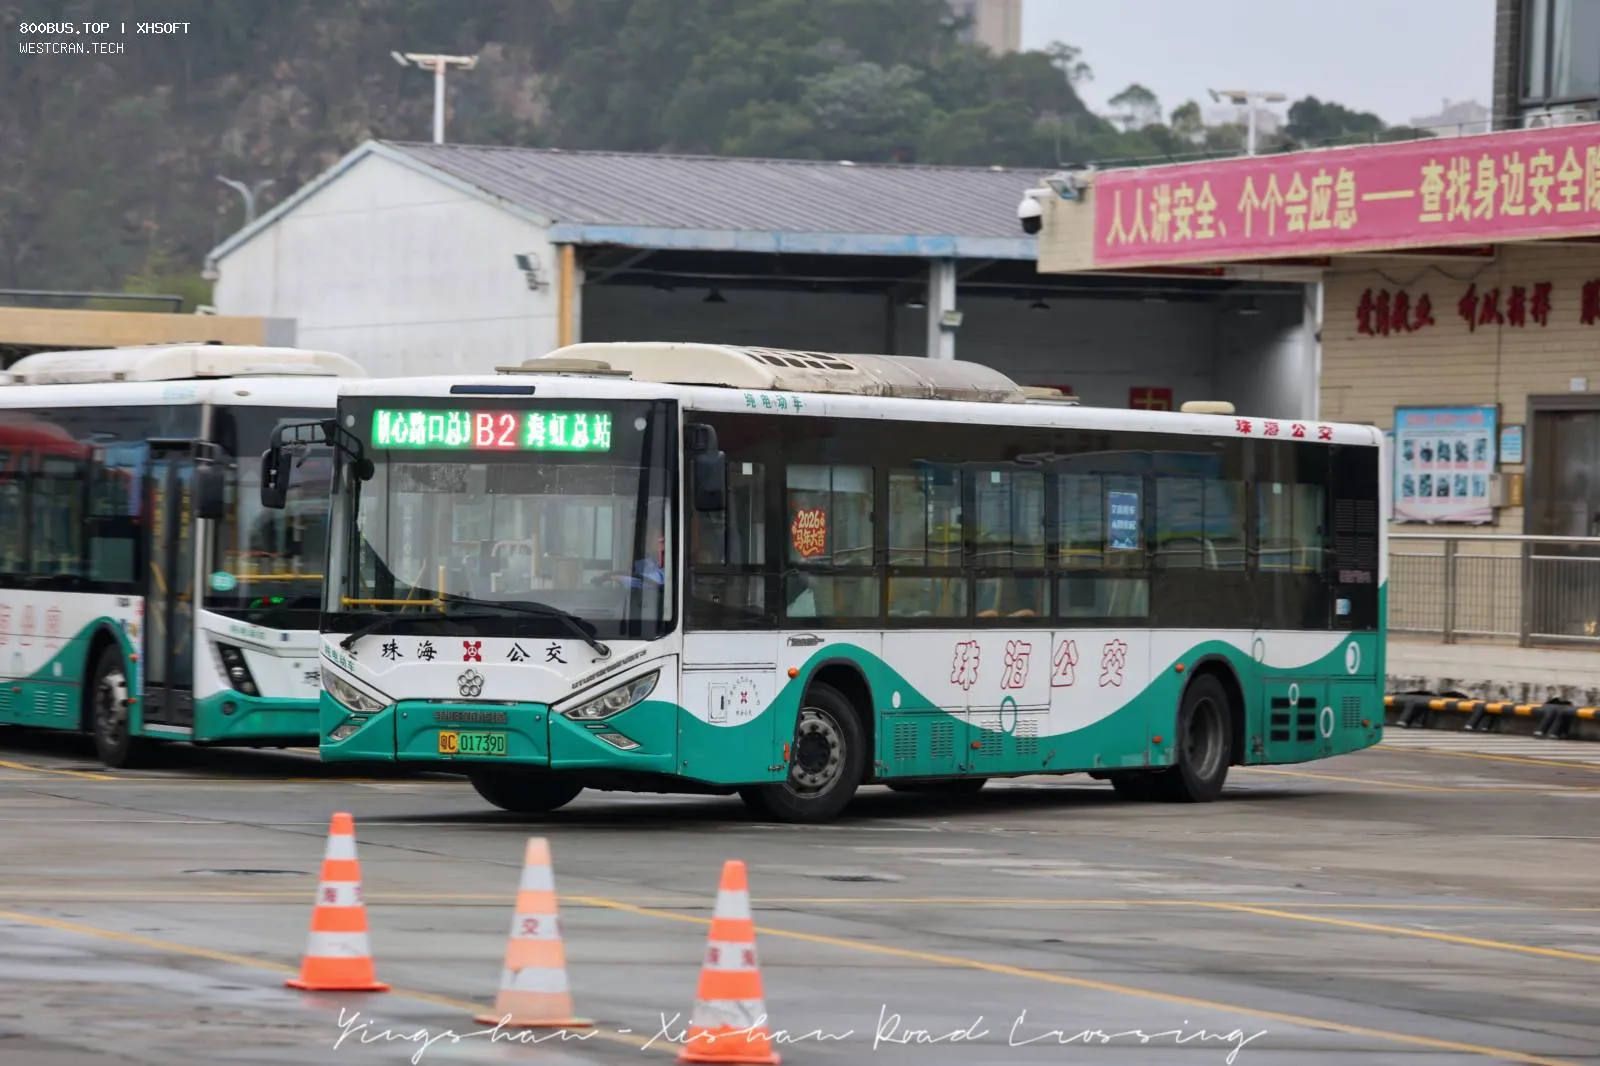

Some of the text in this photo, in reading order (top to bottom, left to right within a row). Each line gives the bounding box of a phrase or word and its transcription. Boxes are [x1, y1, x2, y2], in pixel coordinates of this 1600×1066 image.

[475, 413, 516, 447] B2
[1235, 419, 1333, 441] 珠海公交
[798, 510, 820, 529] 2026
[381, 638, 568, 665] 珠海 公交
[950, 638, 1128, 692] 珠海公交
